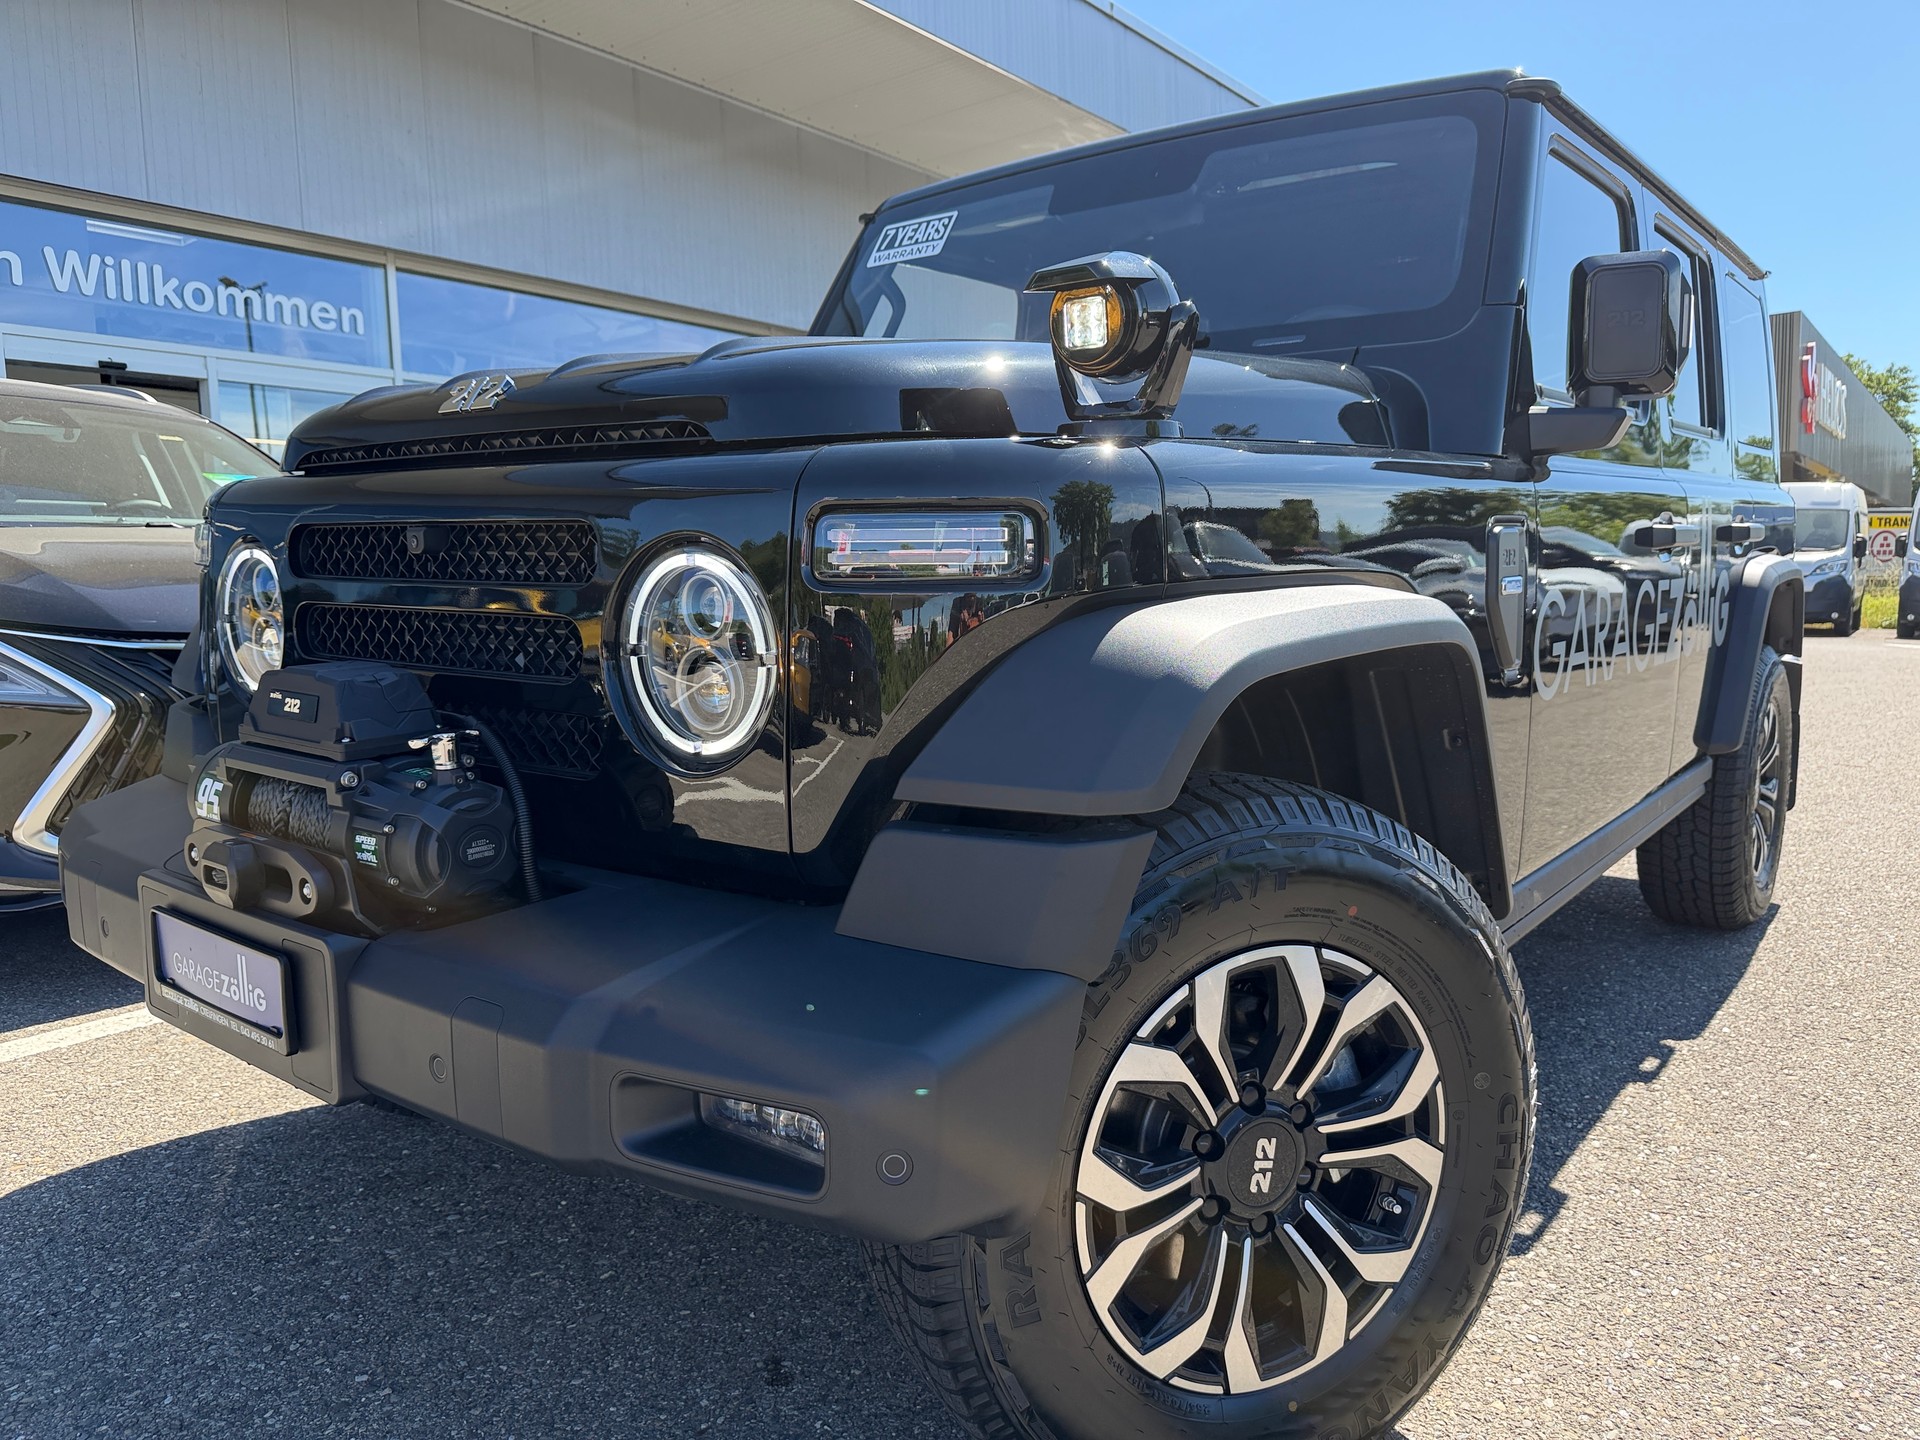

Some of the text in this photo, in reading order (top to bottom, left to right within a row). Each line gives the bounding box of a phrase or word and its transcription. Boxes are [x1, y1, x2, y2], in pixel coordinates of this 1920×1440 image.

[880, 217, 950, 251] 7 YEARS
[873, 243, 940, 264] WARRANTY
[42, 245, 365, 335] Willkommen
[283, 697, 301, 713] 212
[196, 777, 224, 818] 95
[1373, 951, 1395, 968] STEEL
[1249, 1137, 1277, 1194] 212
[1472, 1091, 1519, 1266] CHAO
